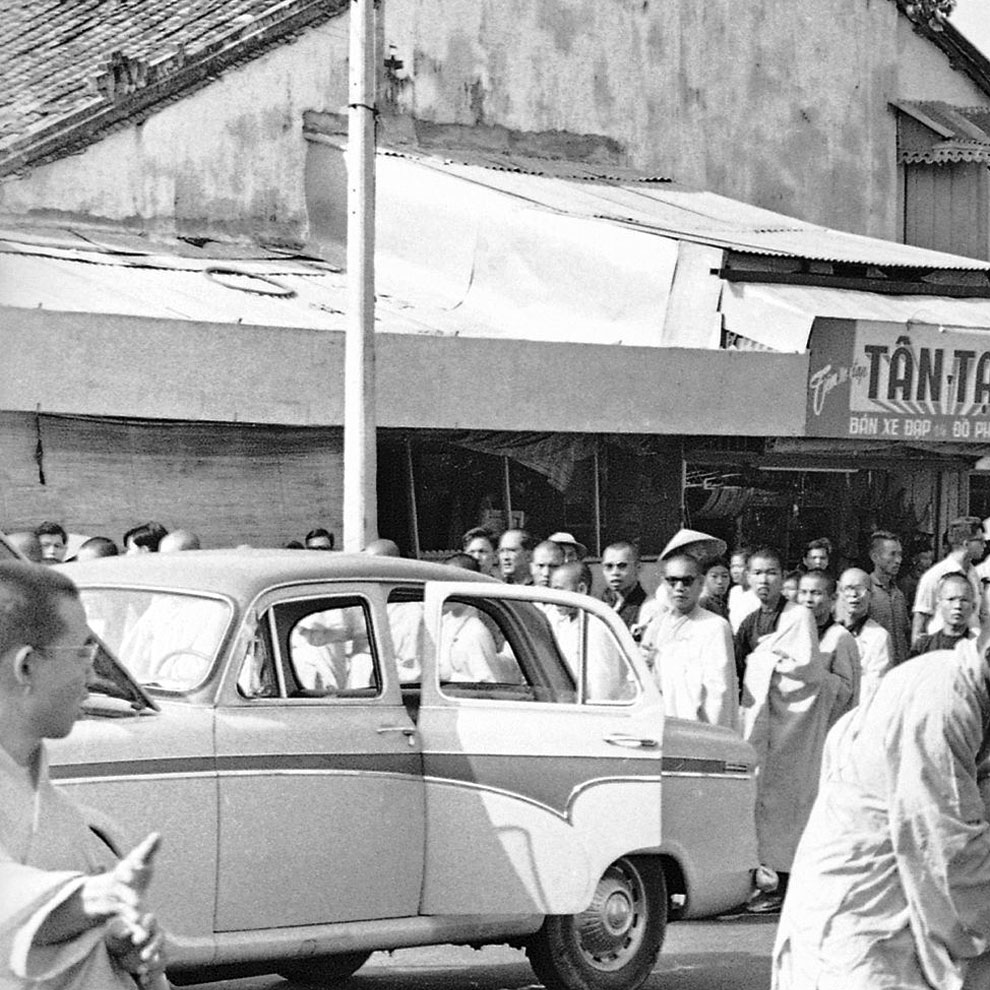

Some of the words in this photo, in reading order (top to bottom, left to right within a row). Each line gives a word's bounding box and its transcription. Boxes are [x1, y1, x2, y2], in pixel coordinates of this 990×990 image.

[849, 414, 878, 434] BÁN
[881, 418, 899, 436] XE
[904, 419, 931, 439] ĐẠP
